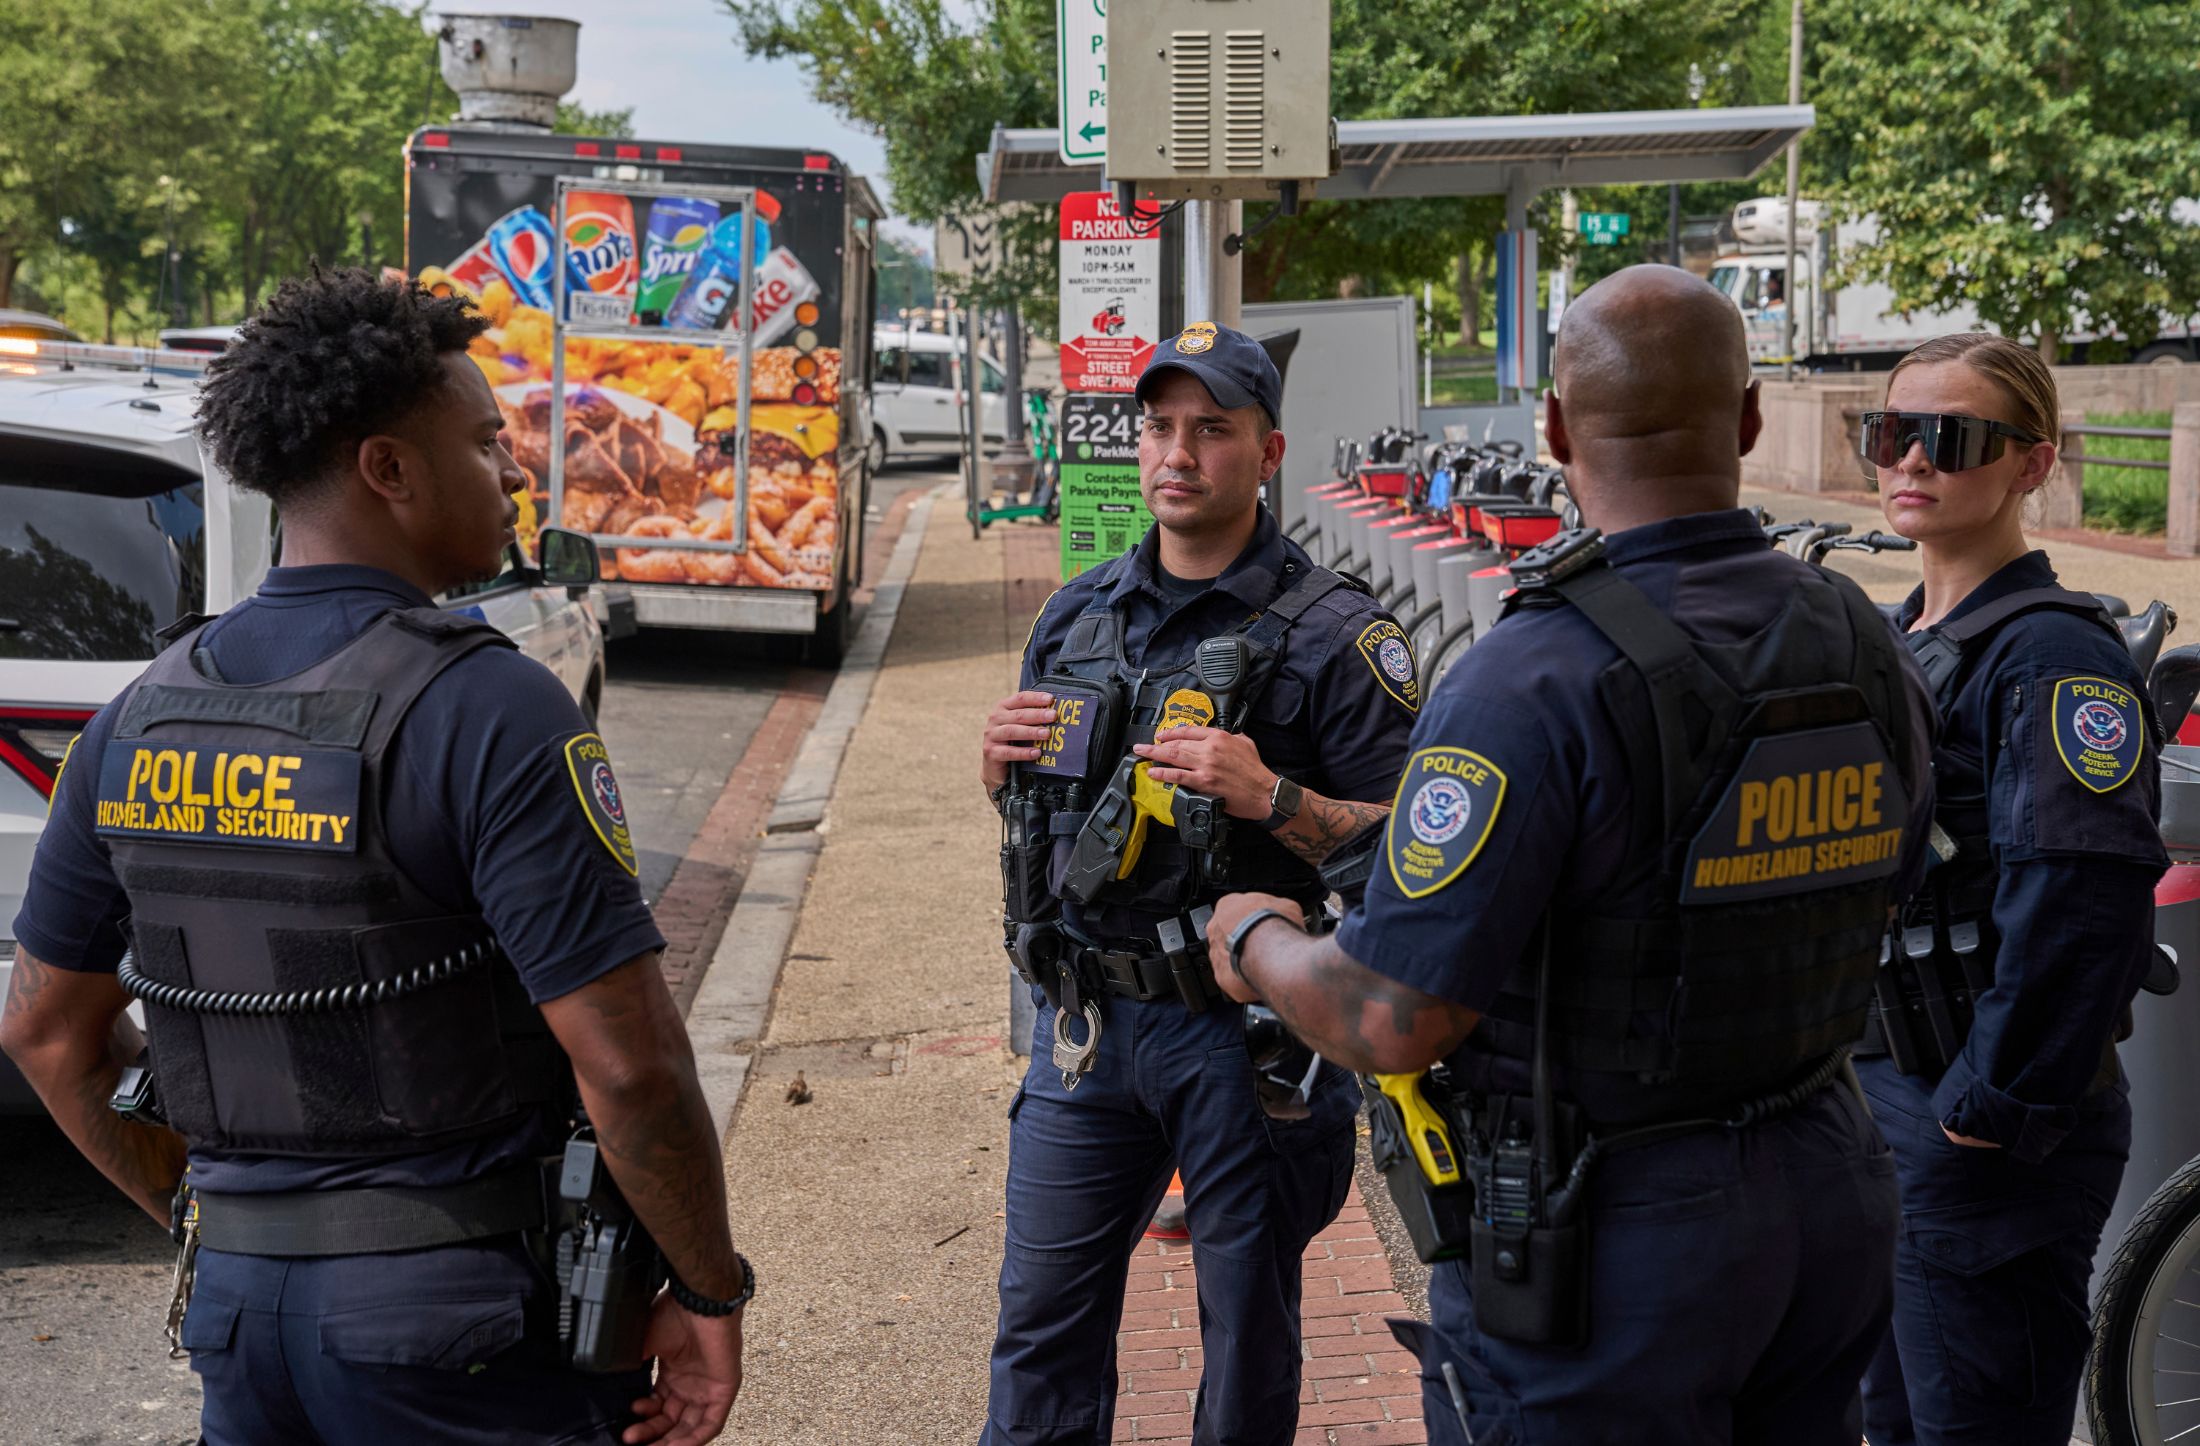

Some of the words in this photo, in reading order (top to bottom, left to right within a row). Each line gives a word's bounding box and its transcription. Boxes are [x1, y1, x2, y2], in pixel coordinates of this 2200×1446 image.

[1072, 220, 1149, 239] PARKING
[565, 231, 632, 277] anta
[1084, 245, 1132, 256] MONDAY
[1082, 262, 1135, 273] 10PM-5AM
[1082, 286, 1105, 294] EXCEPT
[1107, 286, 1137, 294] HOLIDAYS
[1087, 361, 1131, 374] STREET
[1069, 485, 1109, 499] Parking
[1363, 625, 1400, 653] POLICE
[2072, 684, 2128, 708] POLICE
[1181, 706, 1195, 714] DHS
[2078, 755, 2121, 768] PROTECTIVE
[2083, 748, 2116, 760] FEDERAL
[126, 748, 302, 812] POLICE
[1422, 756, 1489, 787] POLICE
[2084, 766, 2115, 777] SERVICE
[1736, 762, 1883, 847] POLICE
[97, 800, 205, 833] HOMELAND
[216, 807, 350, 843] SECURITY
[1401, 846, 1444, 867] PROTECTIVE
[1409, 838, 1443, 857] FEDERAL
[1694, 845, 1813, 888] HOMELAND
[1815, 827, 1903, 873] SECURITY
[1402, 862, 1433, 879] SERVICE
